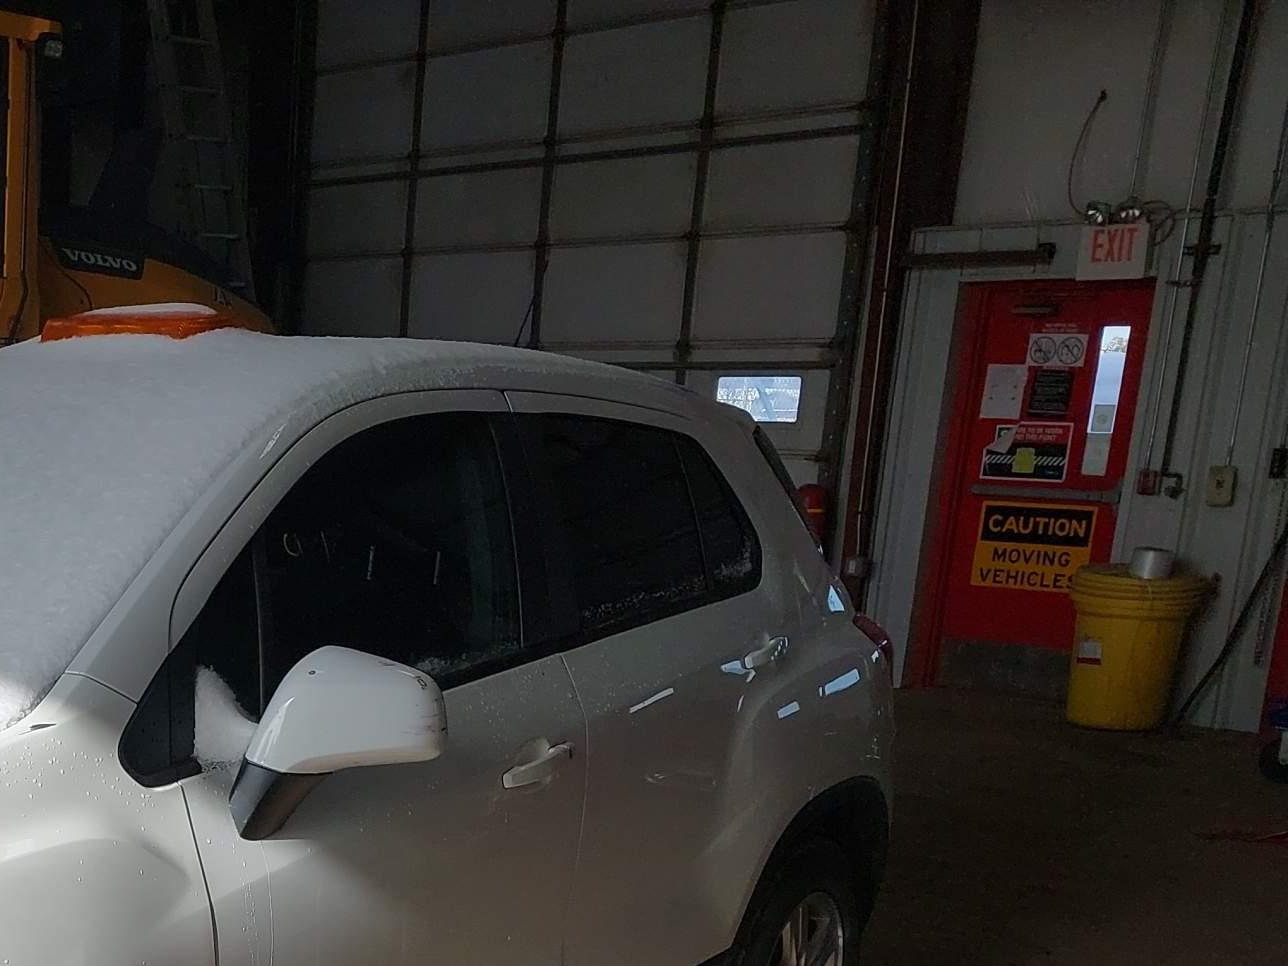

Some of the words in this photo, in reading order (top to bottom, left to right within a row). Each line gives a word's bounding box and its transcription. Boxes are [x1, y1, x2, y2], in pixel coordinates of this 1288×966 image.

[1091, 227, 1139, 263] EXIT
[61, 247, 136, 271] VOLVO
[988, 513, 1088, 538] CAUTION
[992, 547, 1071, 567] MOVING
